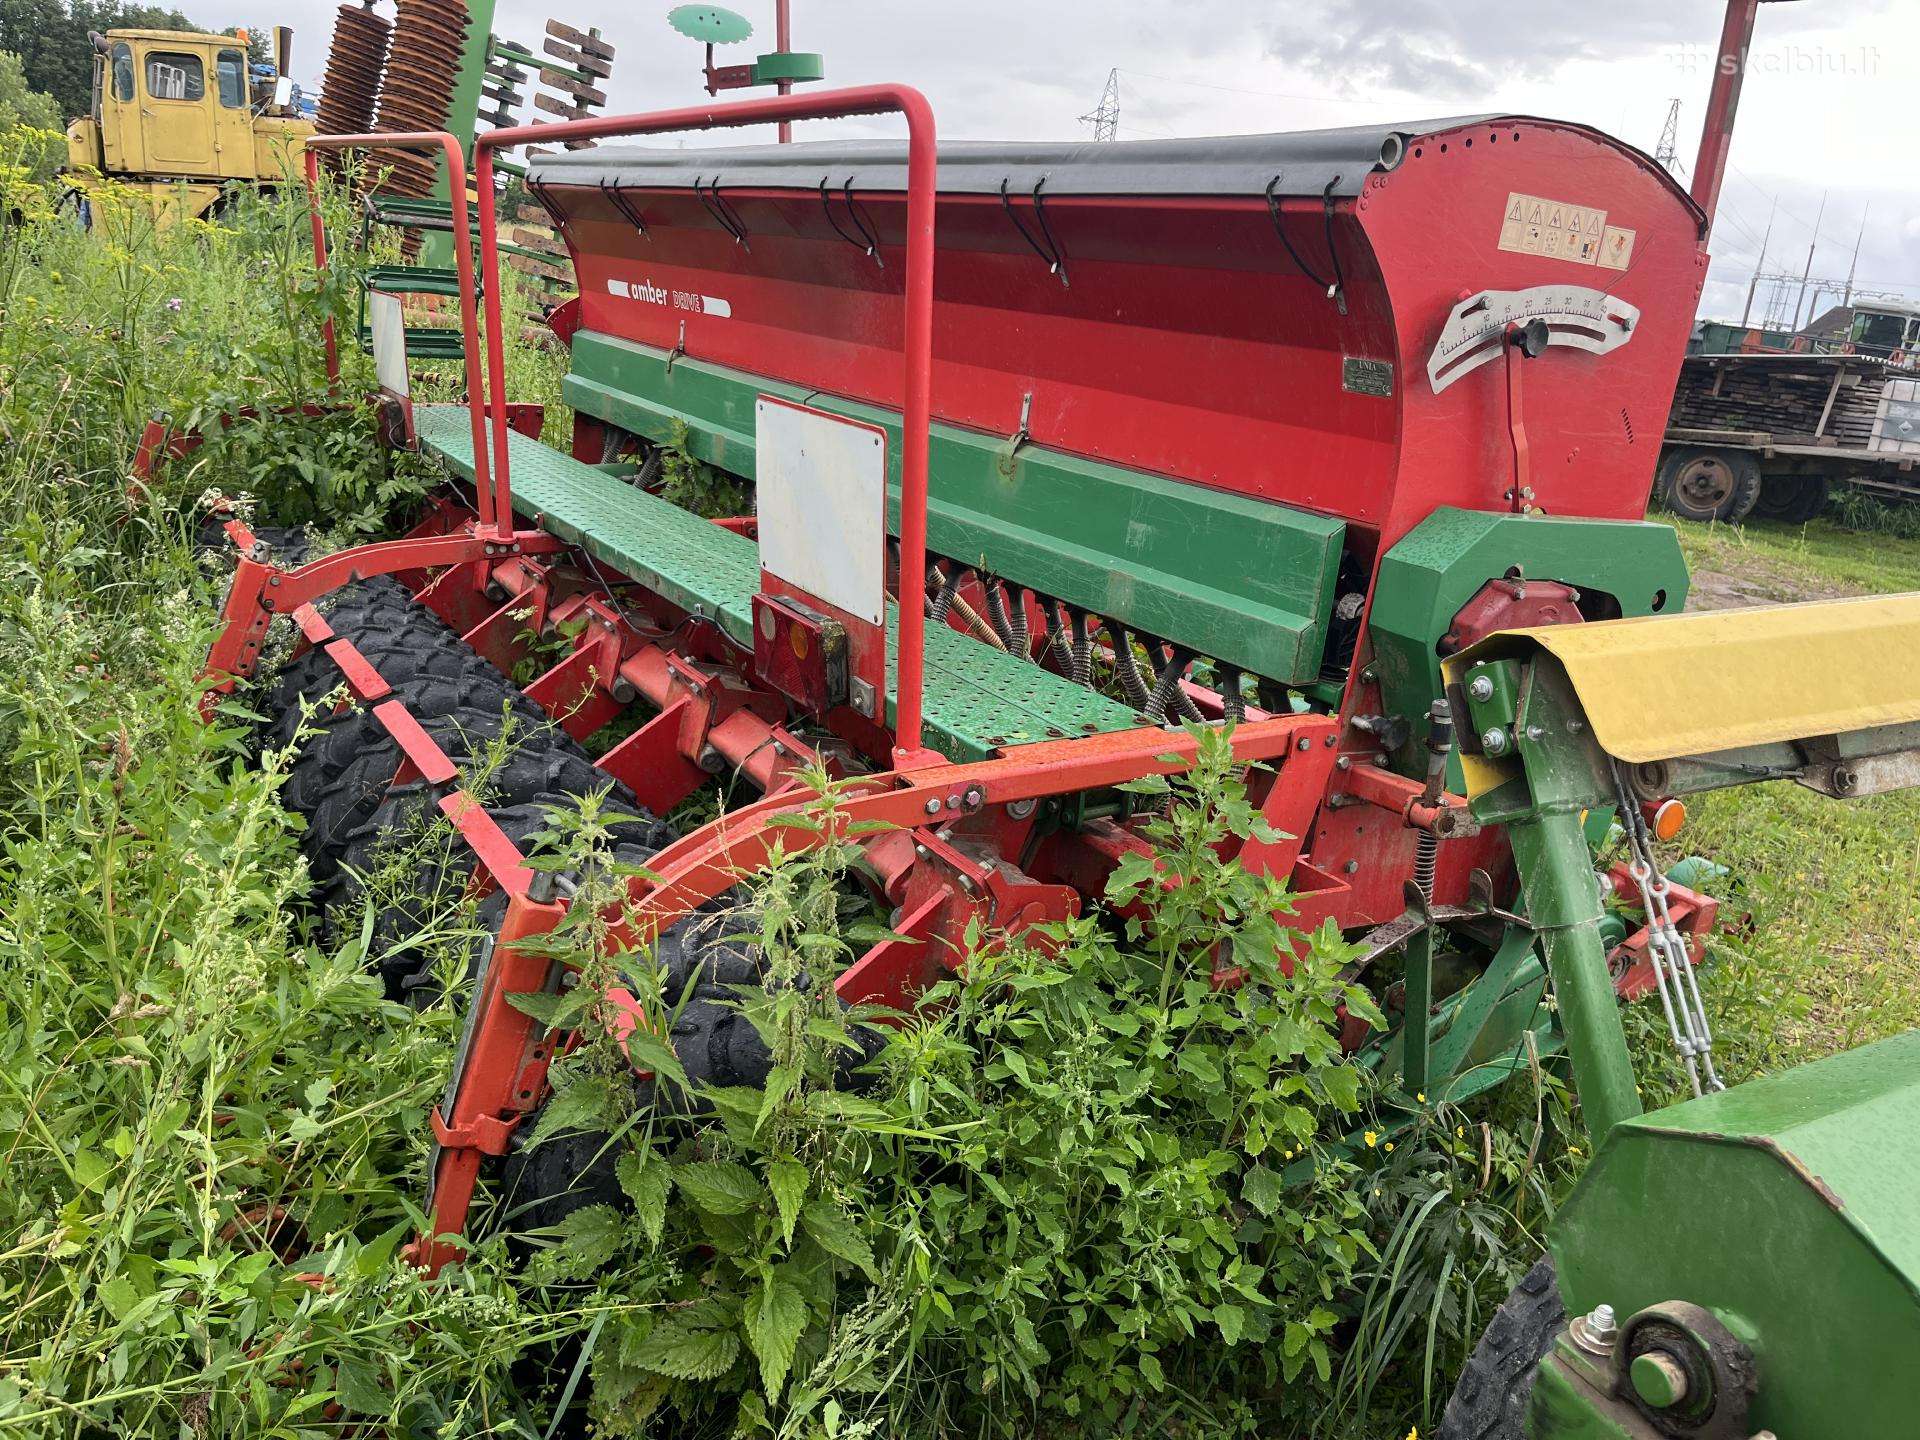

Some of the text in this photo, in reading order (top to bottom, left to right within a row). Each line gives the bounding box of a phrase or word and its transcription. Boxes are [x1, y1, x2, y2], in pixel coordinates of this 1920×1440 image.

[631, 279, 701, 313] amber DRIVE
[1359, 361, 1377, 371] UNIA
